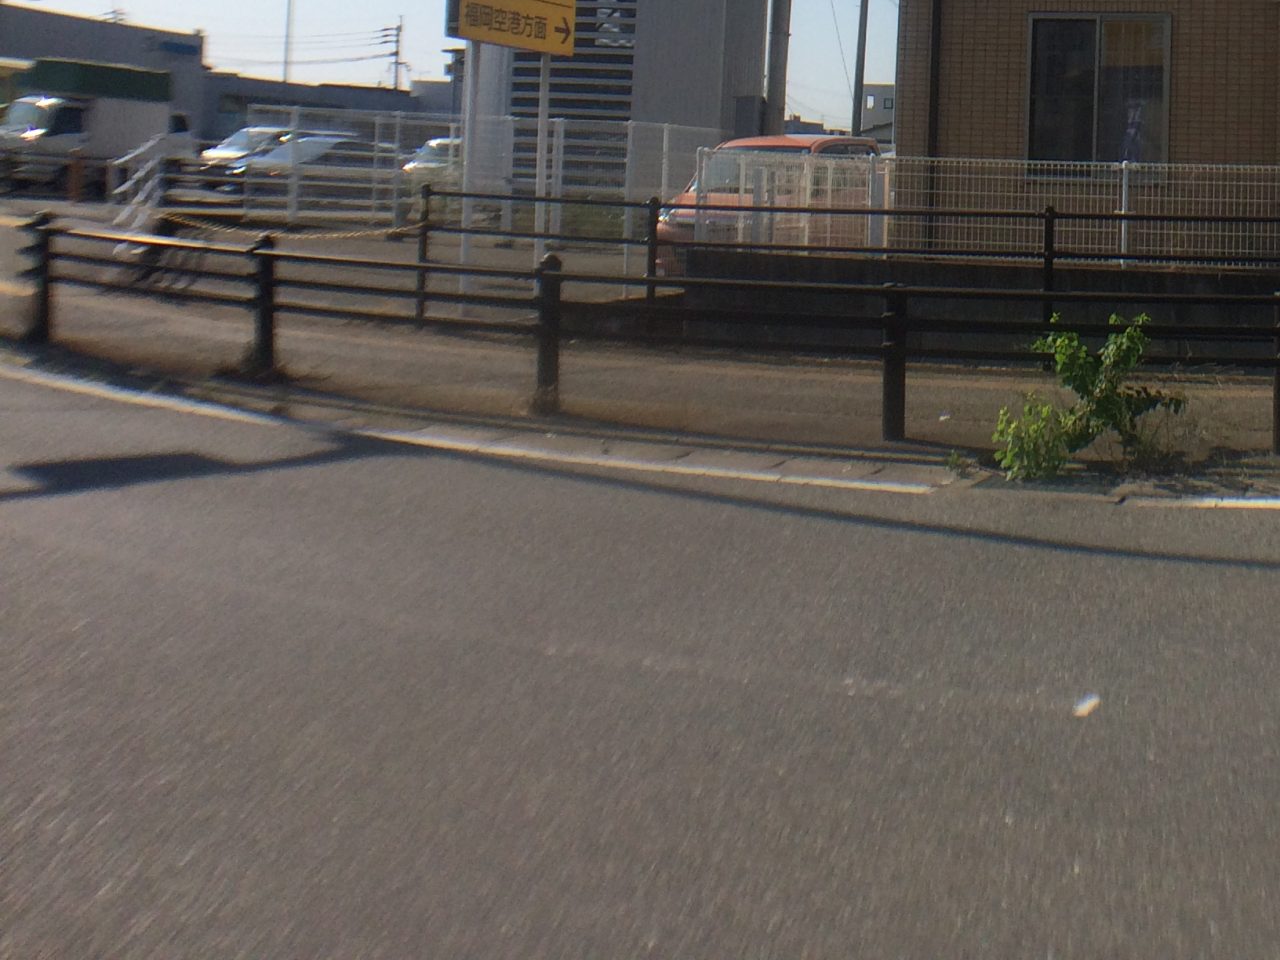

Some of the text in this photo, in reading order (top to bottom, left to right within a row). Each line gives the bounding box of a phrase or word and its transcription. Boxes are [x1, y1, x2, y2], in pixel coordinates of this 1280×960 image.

[465, 1, 548, 40] 福岡空港方面
